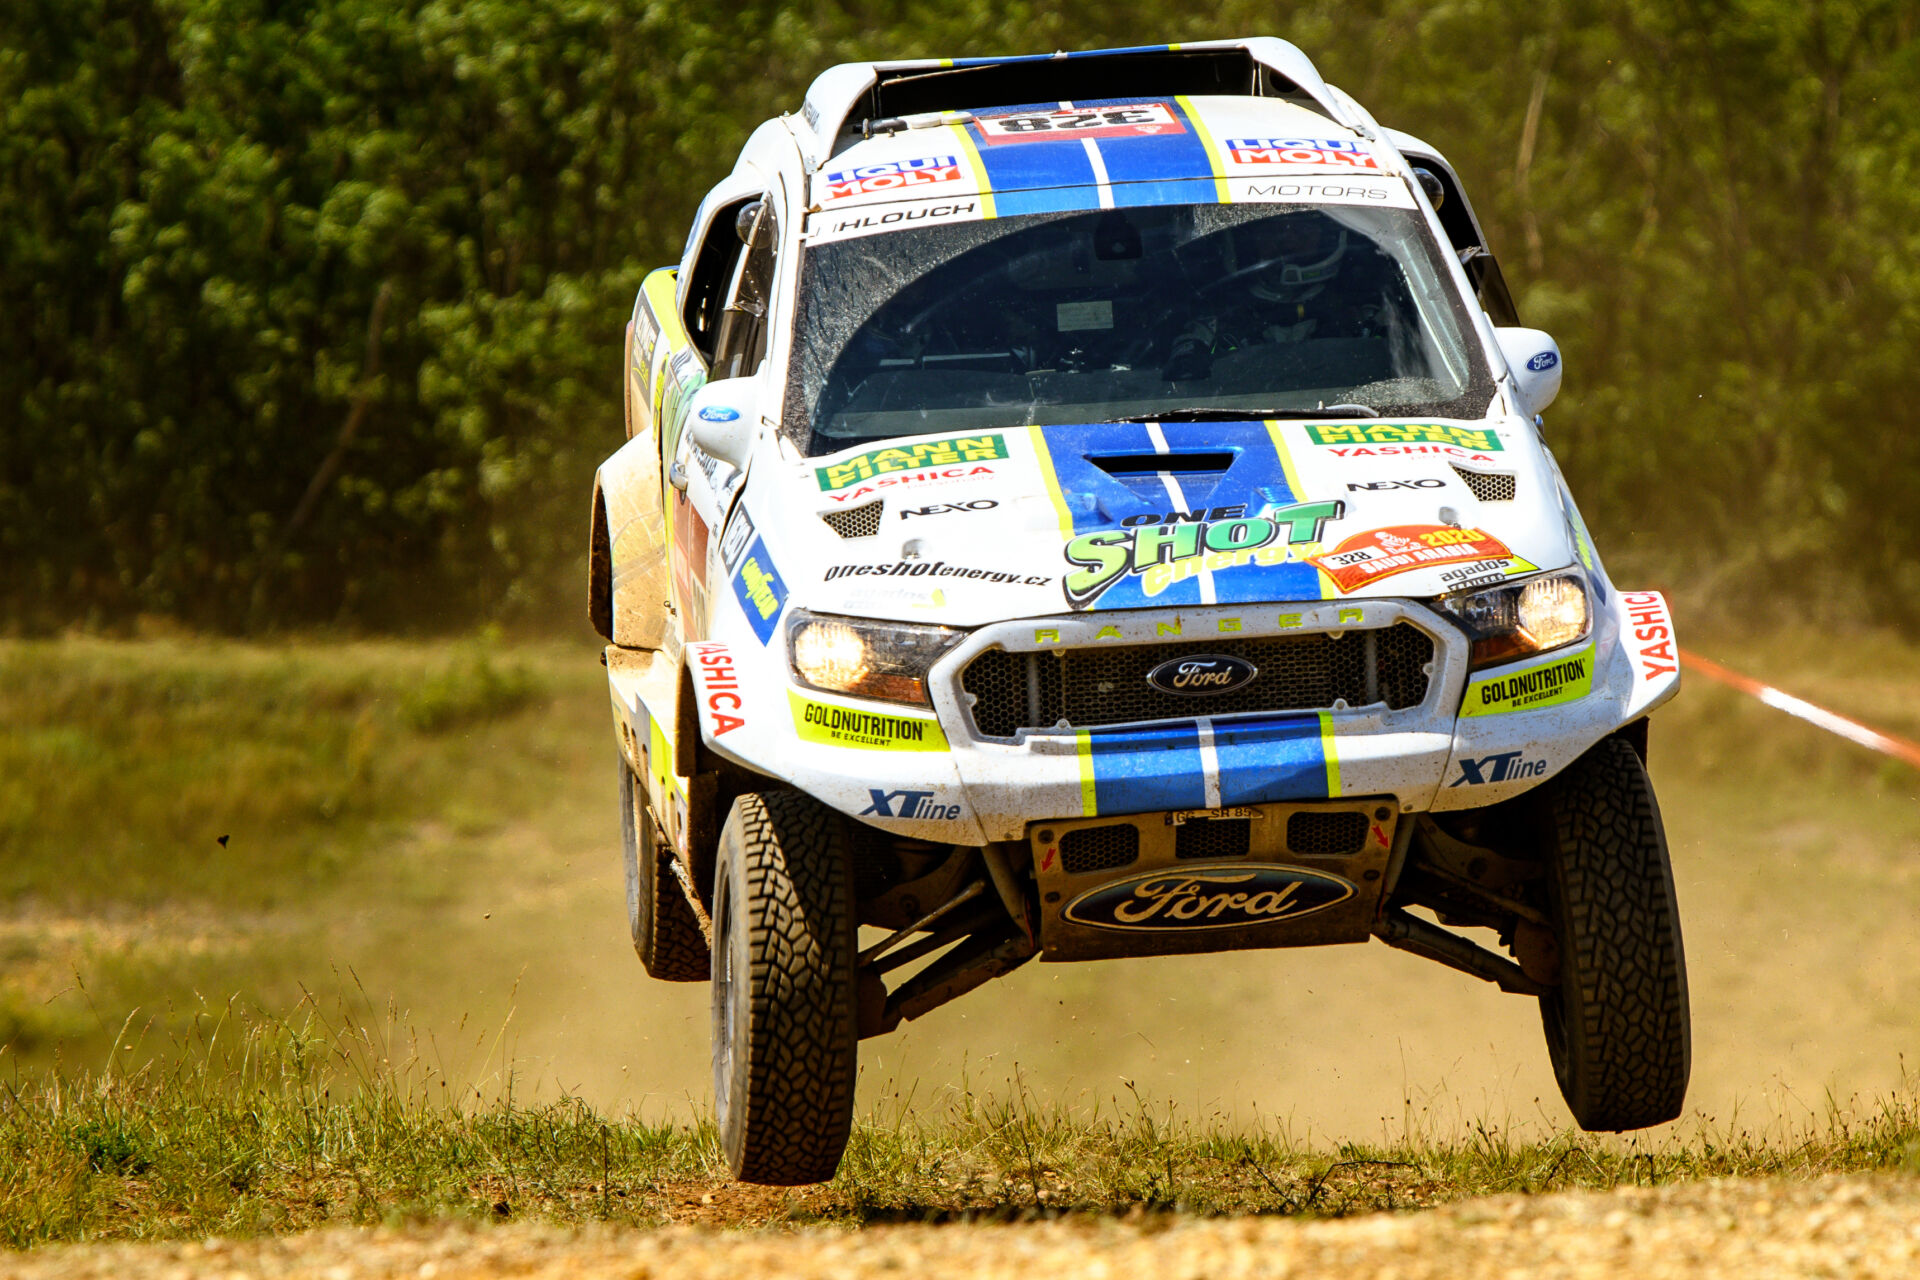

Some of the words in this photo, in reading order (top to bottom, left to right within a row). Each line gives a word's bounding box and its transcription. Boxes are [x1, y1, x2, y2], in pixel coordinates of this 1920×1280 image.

[999, 111, 1156, 132] 328
[1230, 139, 1367, 153] LIQUI
[828, 156, 957, 185] LIQUI
[1236, 149, 1373, 168] MOLY
[825, 166, 959, 200] MOLY
[1248, 185, 1388, 200] MOTORS
[838, 203, 976, 232] HLOUCH
[1533, 353, 1554, 370] Ford
[1316, 425, 1487, 441] MANN
[1320, 433, 1493, 450] FILTER
[827, 436, 994, 478] MANN
[1327, 446, 1496, 462] YASHICA
[829, 448, 998, 488] FILTER
[829, 466, 994, 502] YASHICA
[1347, 479, 1446, 492] NEXO
[900, 500, 998, 520] NEXO
[1121, 504, 1248, 527] ONE
[1419, 529, 1486, 548] 2020
[1063, 500, 1345, 610] SHOT
[1332, 551, 1372, 566] 328
[1358, 554, 1416, 574] SAUDI
[1412, 543, 1479, 564] ARABIA
[824, 561, 1053, 587] oneshotenergy.cz
[1438, 559, 1510, 581] agados
[1035, 608, 1363, 644] RANGER
[1173, 661, 1233, 688] Ford
[1481, 658, 1586, 705] GOLDNUTRITION
[1512, 697, 1522, 708] BE
[1524, 686, 1564, 705] EXCELLENT
[804, 703, 924, 742] GOLDNUTRITION
[831, 730, 842, 739] BE
[844, 733, 892, 747] EXCELLENT
[1448, 751, 1547, 788] XTline
[858, 789, 961, 820] XTline
[1113, 873, 1304, 923] Ford
